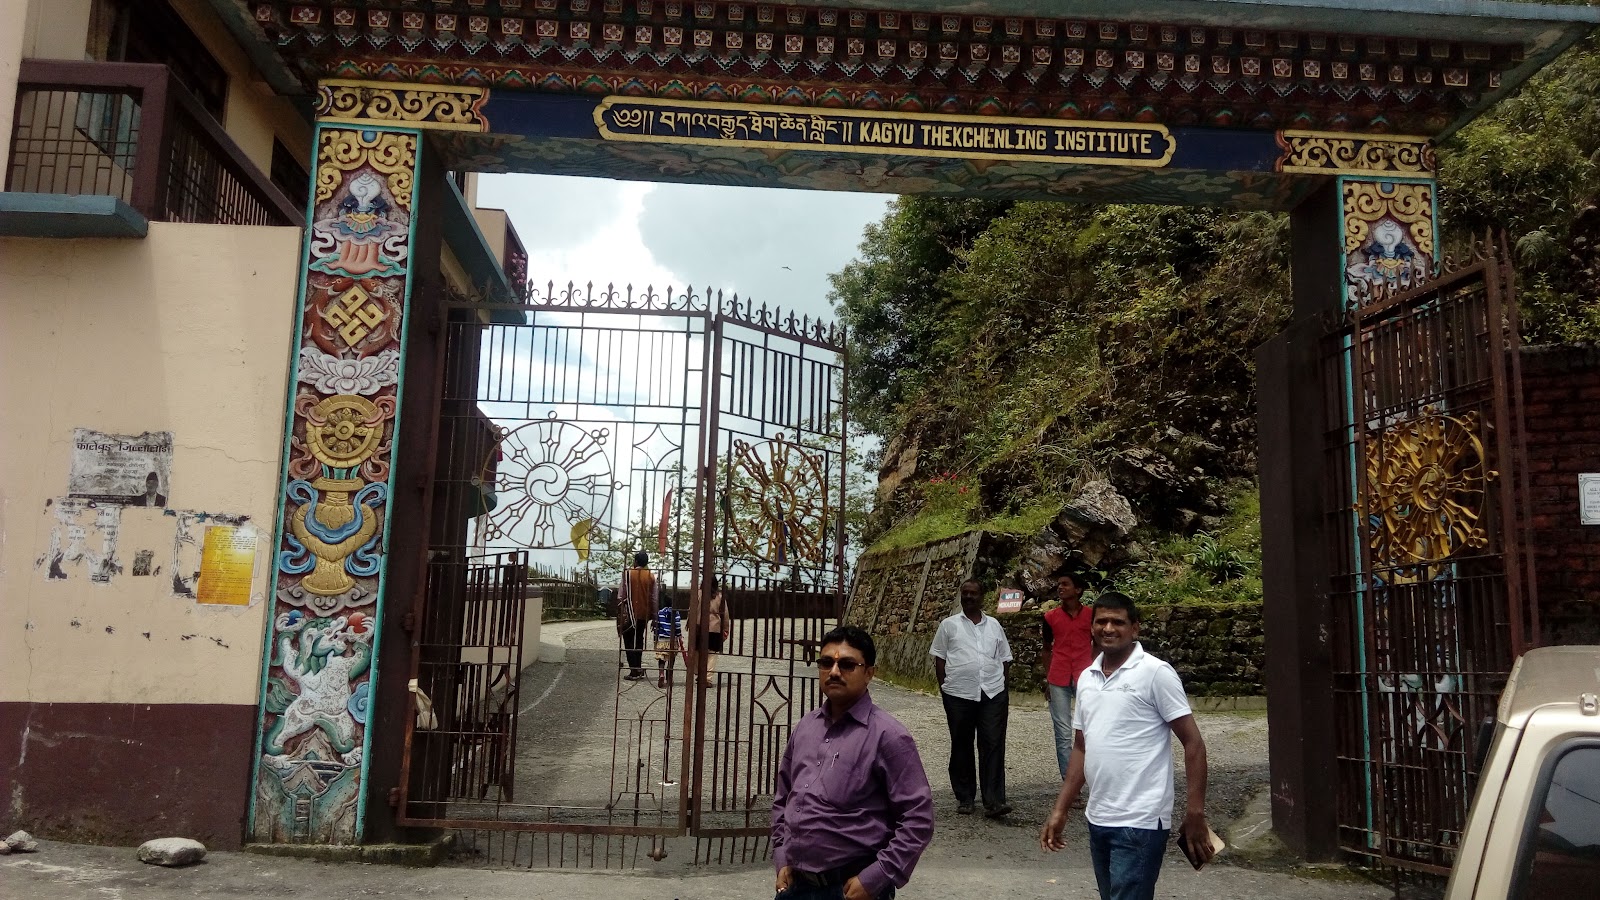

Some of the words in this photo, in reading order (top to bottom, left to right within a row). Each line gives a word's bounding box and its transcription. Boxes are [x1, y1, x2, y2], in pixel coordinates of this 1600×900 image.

[859, 121, 914, 145] KAGYU
[921, 125, 1047, 150] THEKCHENLING
[1054, 130, 1152, 154] INSTITUTE
